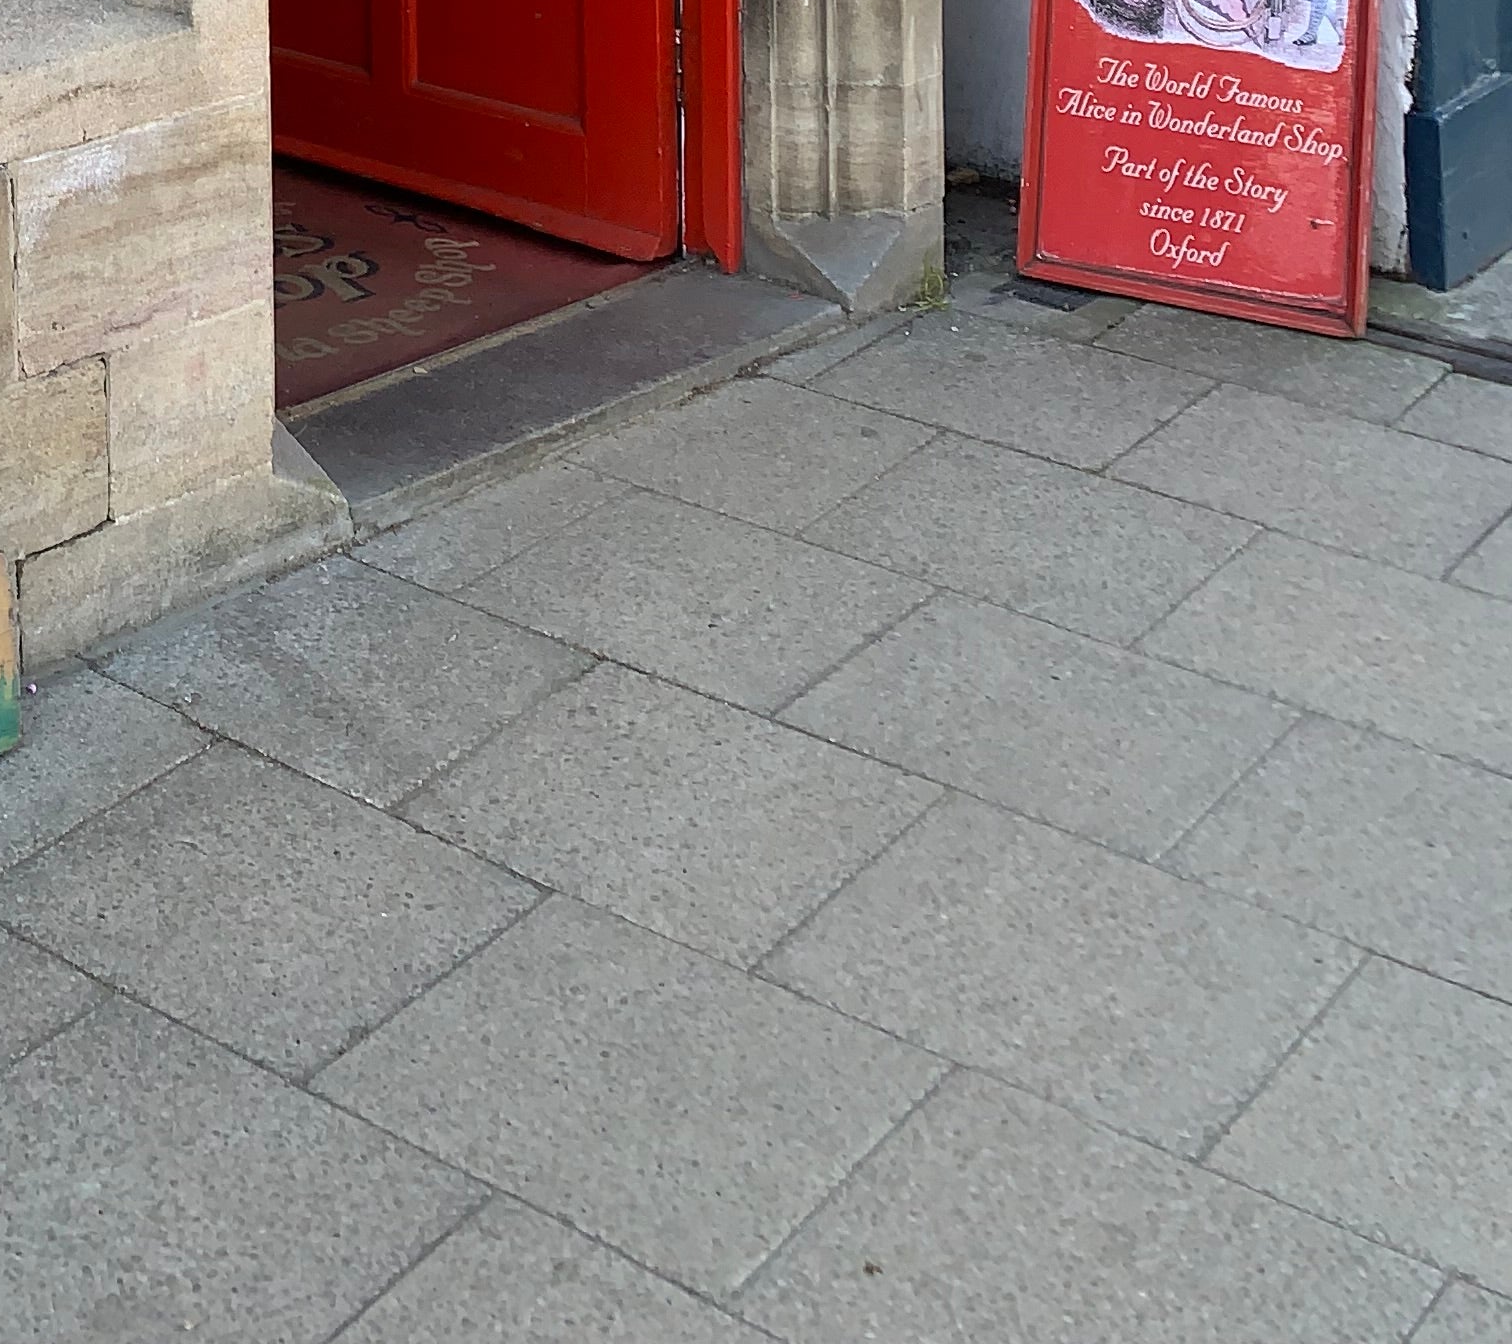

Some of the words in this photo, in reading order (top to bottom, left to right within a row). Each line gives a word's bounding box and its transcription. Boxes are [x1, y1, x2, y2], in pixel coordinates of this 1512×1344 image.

[1097, 57, 1139, 88] The
[1144, 63, 1215, 100] World
[1216, 75, 1304, 114] Famous
[1056, 87, 1117, 123] Alice
[1120, 102, 1142, 126] in
[1147, 100, 1286, 149] Wonderland
[1102, 146, 1157, 179] Part
[1159, 158, 1185, 192] of
[1184, 163, 1218, 191] the
[1224, 167, 1288, 213] Story
[1139, 198, 1193, 225] since
[1199, 207, 1246, 233] 1871
[416, 236, 496, 287] Shop
[1150, 228, 1231, 269] Oxford
